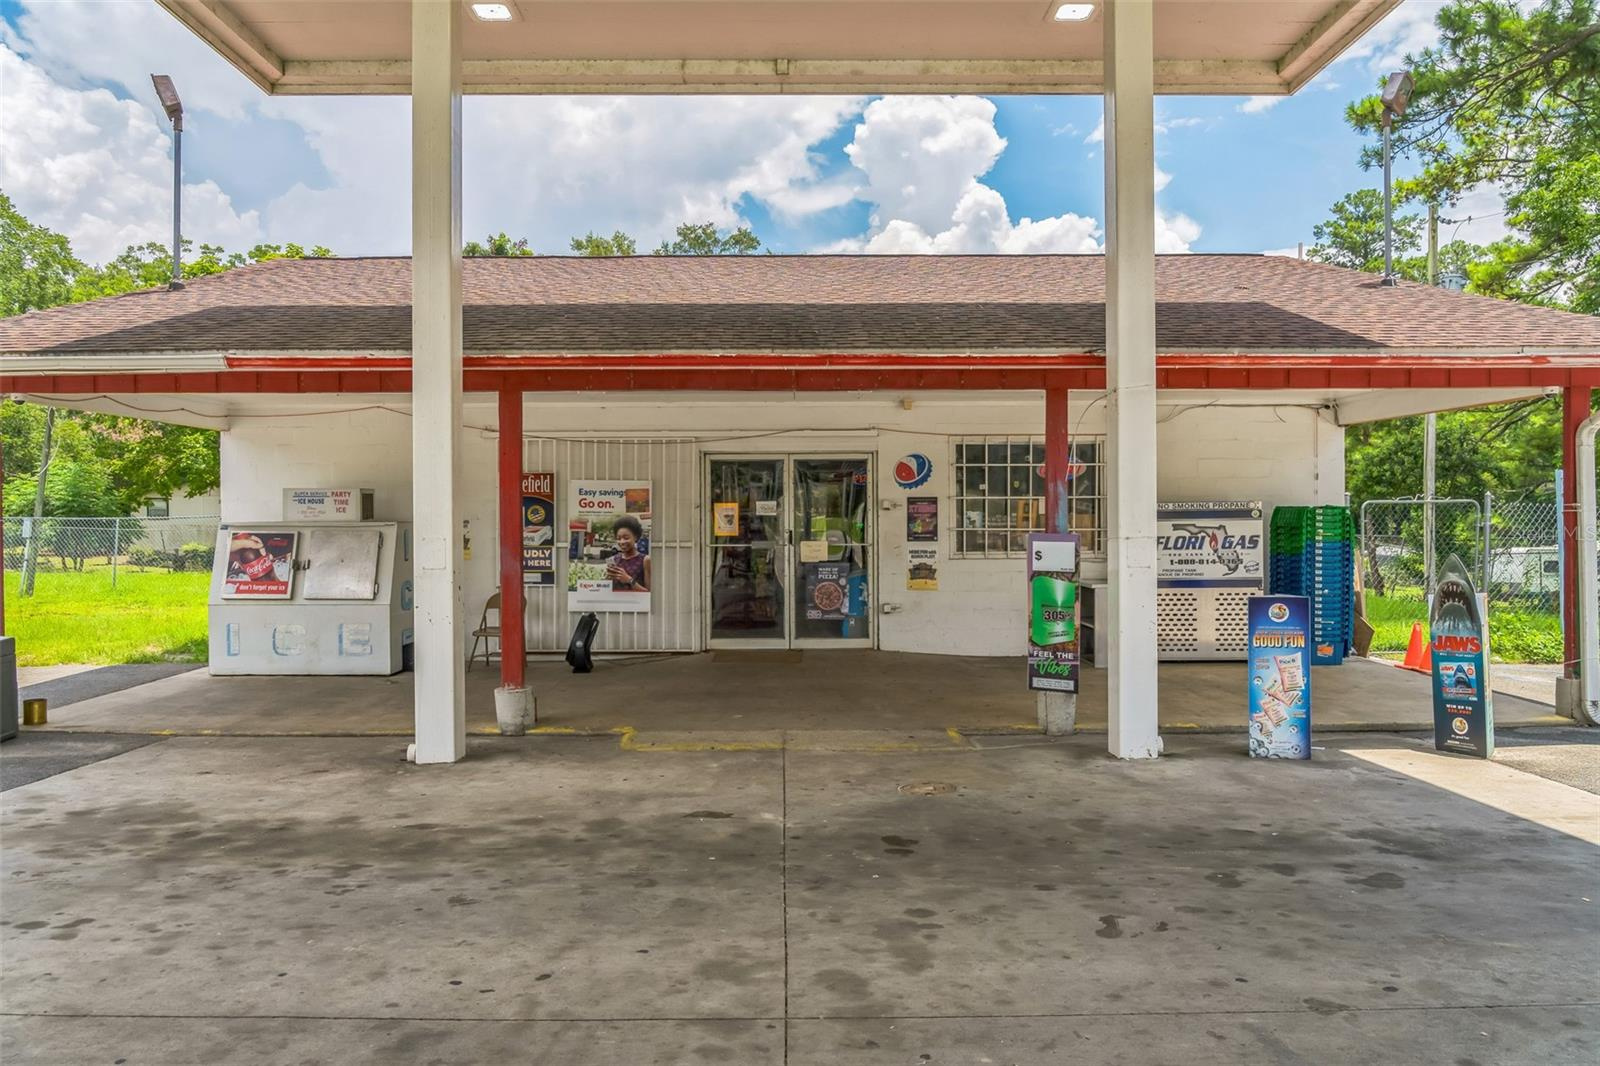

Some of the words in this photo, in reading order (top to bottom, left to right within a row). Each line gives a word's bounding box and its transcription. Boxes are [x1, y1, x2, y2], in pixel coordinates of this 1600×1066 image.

[522, 474, 550, 493] efield
[578, 488, 597, 498] Easy
[578, 498, 596, 509] Go
[597, 500, 615, 509] on.
[1158, 502, 1170, 510] NO
[1172, 502, 1210, 510] SMOKING
[1221, 535, 1261, 550] GAS
[524, 549, 551, 558] UDLY
[1034, 550, 1043, 562] $
[246, 556, 273, 575] Coca-Cola
[527, 560, 552, 568] HERE
[1253, 634, 1282, 648] GOOD
[1284, 634, 1305, 648] FUN
[1433, 635, 1482, 653] JAWS
[1033, 650, 1055, 659] FEEL
[1056, 652, 1074, 660] THE
[1033, 657, 1073, 677] Vibes
